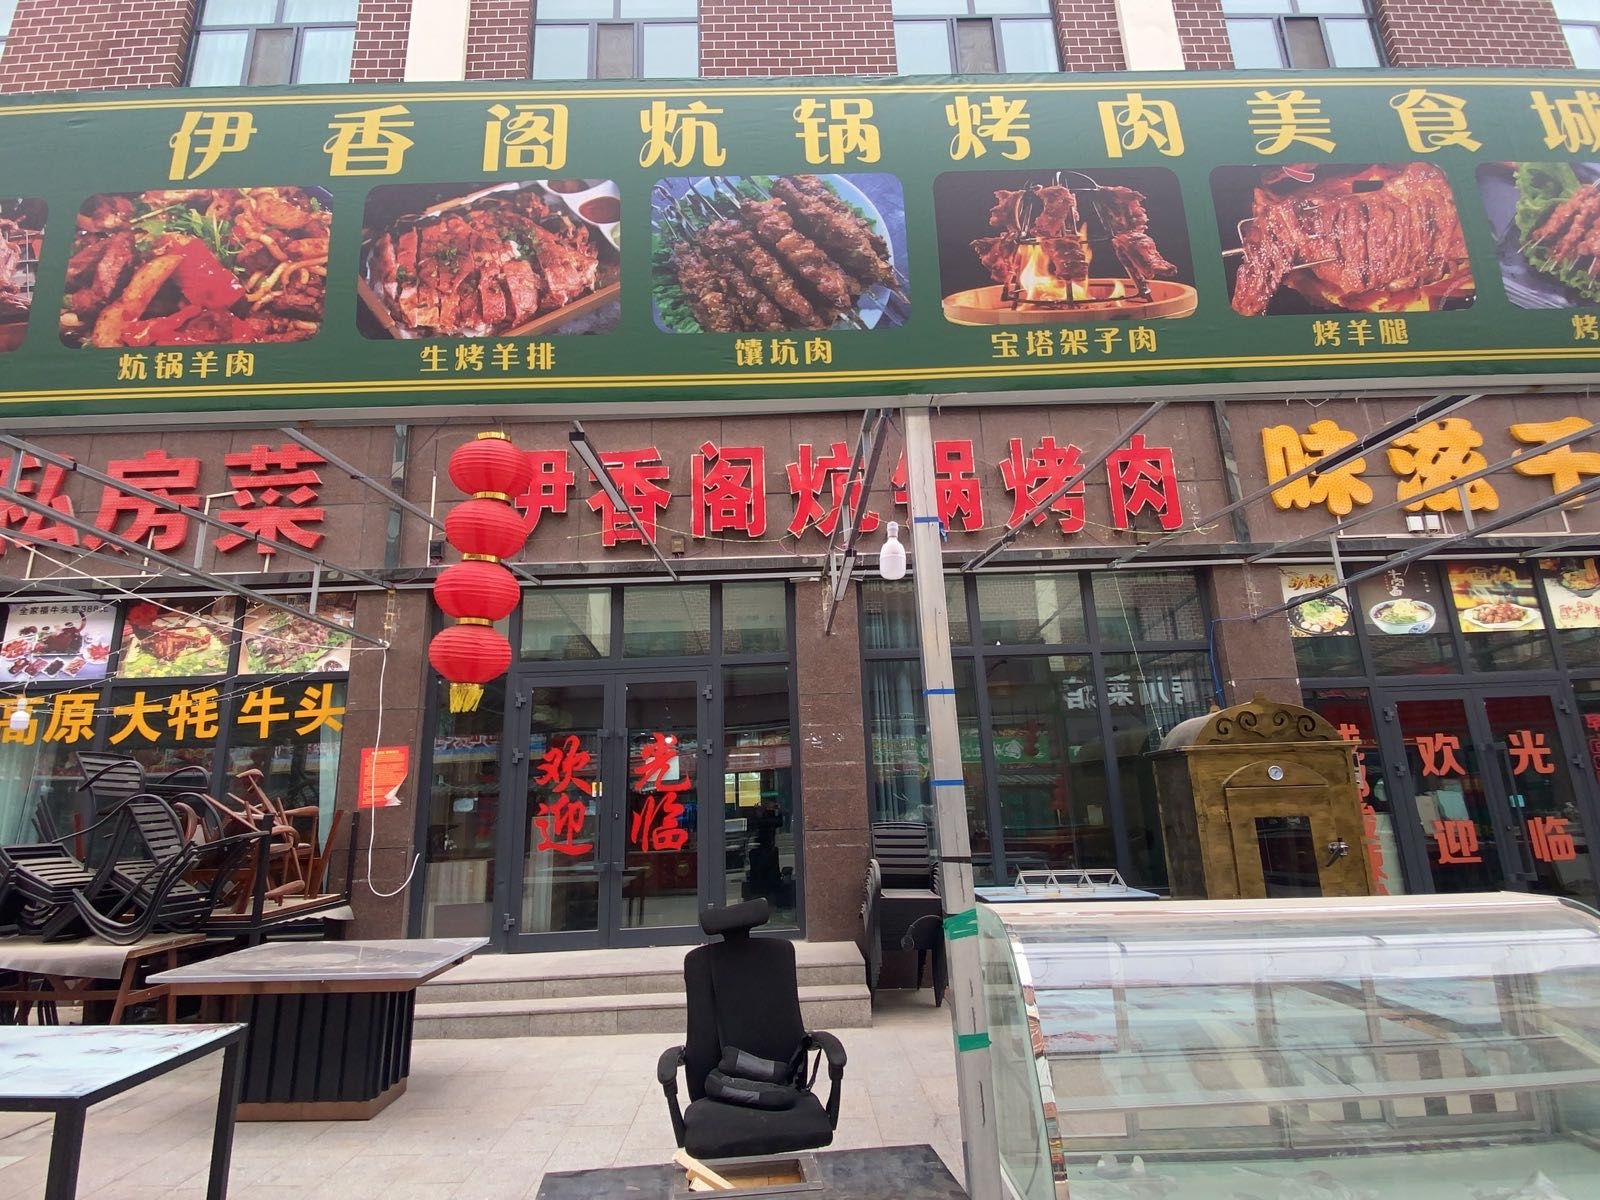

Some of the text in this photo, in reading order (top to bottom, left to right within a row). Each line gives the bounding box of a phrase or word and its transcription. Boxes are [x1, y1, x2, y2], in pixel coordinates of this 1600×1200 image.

[167, 86, 1600, 182] 伊香阁炕锅烤肉美食城
[117, 351, 256, 381] 炕锅羊肉
[420, 343, 556, 372] 生烤羊排
[735, 337, 832, 366] 馕坑肉
[991, 327, 1158, 359] 宝塔架子肉
[1312, 319, 1409, 348] 烤羊腿
[0, 443, 327, 555] 私房菜
[0, 683, 347, 745] 高原大牦牛头
[534, 735, 593, 856] 欢迎
[631, 732, 692, 853] 光临
[1416, 733, 1482, 864] 欢迎
[1508, 730, 1576, 862] 光临
